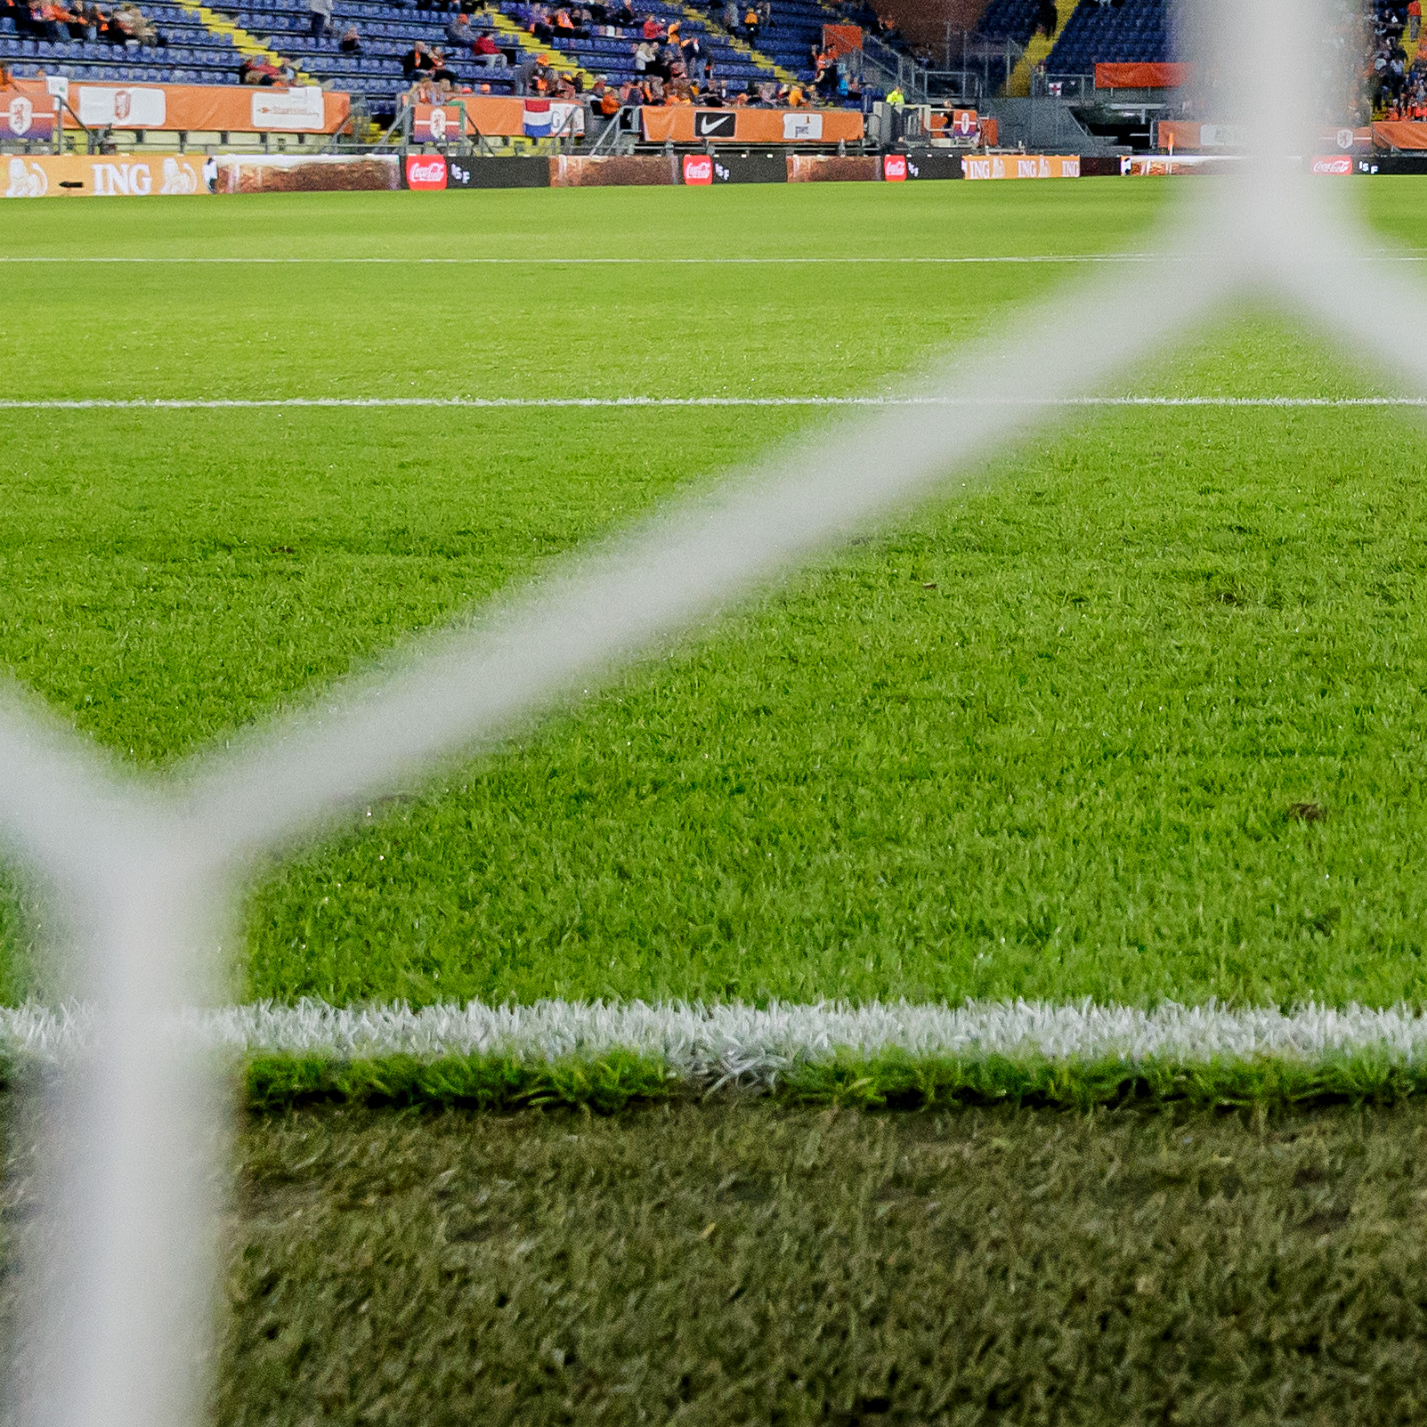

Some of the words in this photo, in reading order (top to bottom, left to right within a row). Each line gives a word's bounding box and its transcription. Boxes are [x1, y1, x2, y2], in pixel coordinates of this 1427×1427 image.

[970, 160, 990, 178] ING
[1017, 160, 1036, 177] ING
[1062, 160, 1079, 177] ING
[92, 163, 151, 196] ING
